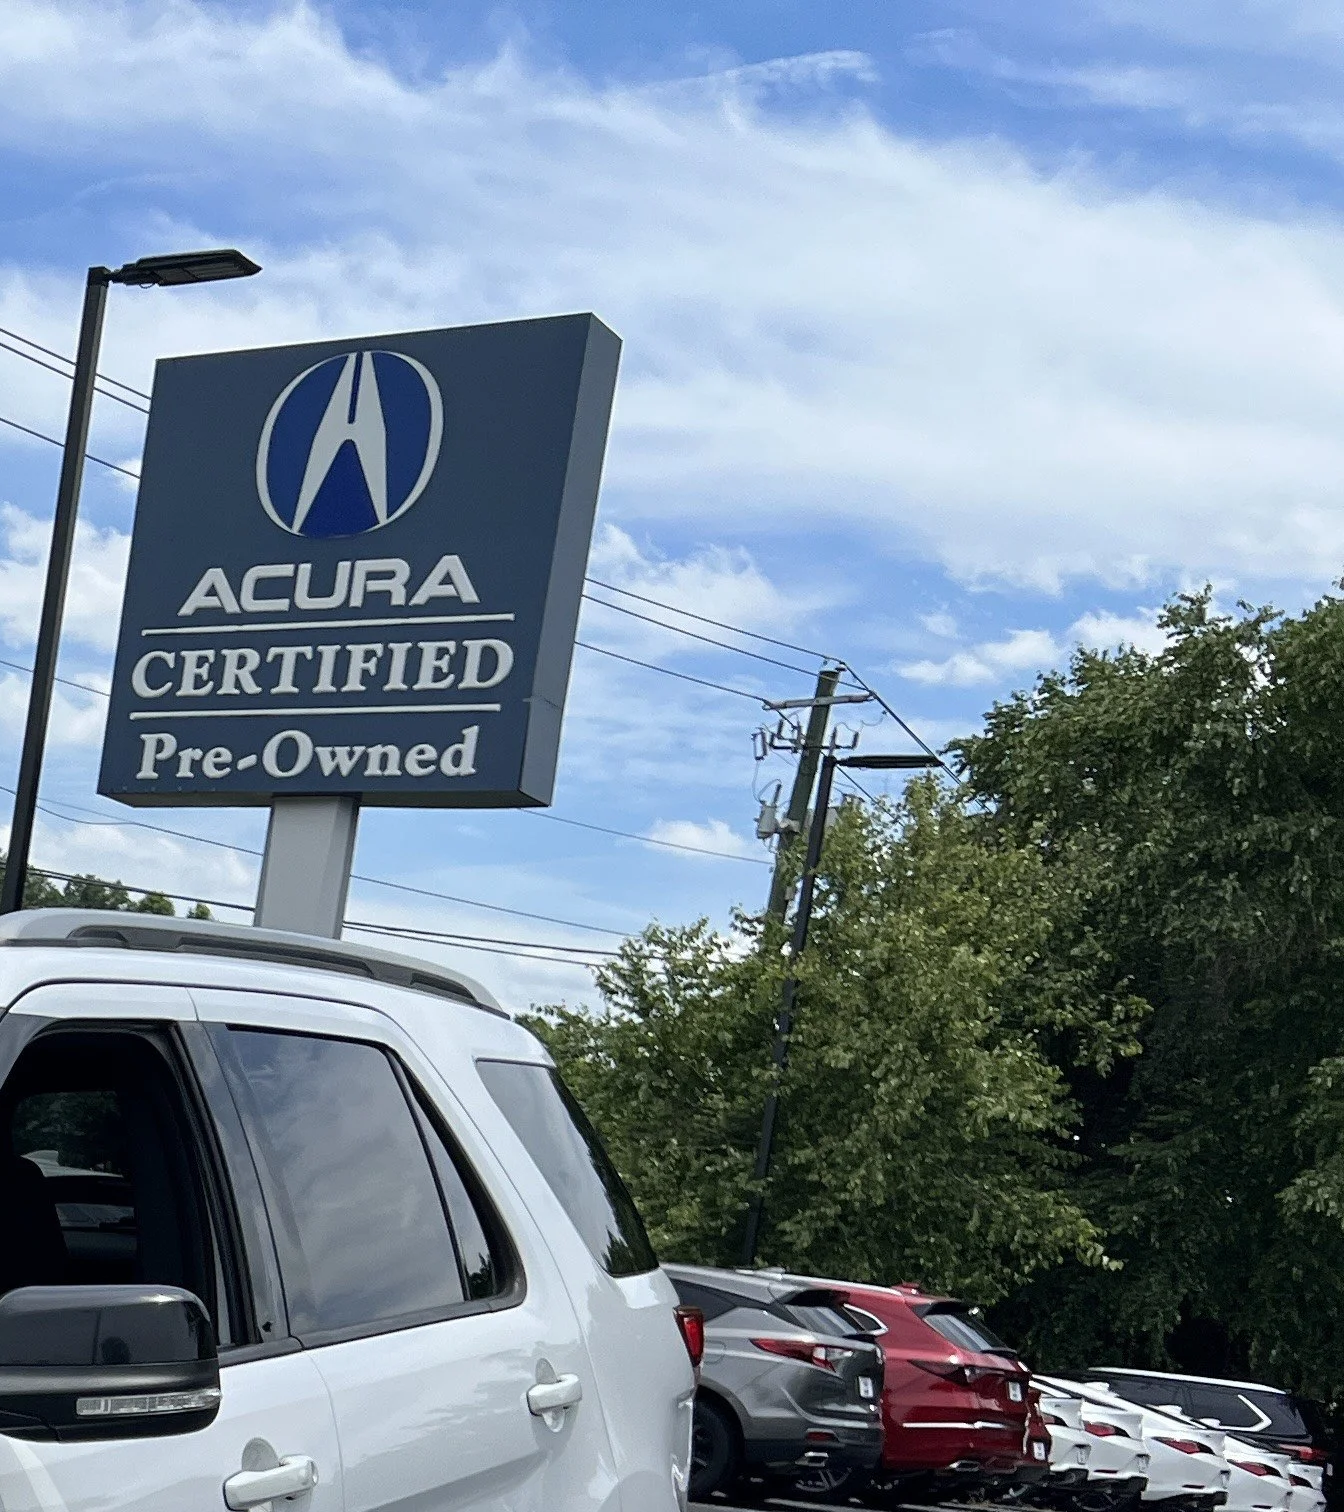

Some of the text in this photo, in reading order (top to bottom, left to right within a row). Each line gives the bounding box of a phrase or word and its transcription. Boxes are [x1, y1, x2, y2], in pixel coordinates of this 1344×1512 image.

[177, 554, 481, 616] ACURA
[130, 638, 514, 699] CERTIFIED
[135, 725, 480, 780] Pre-Owned
